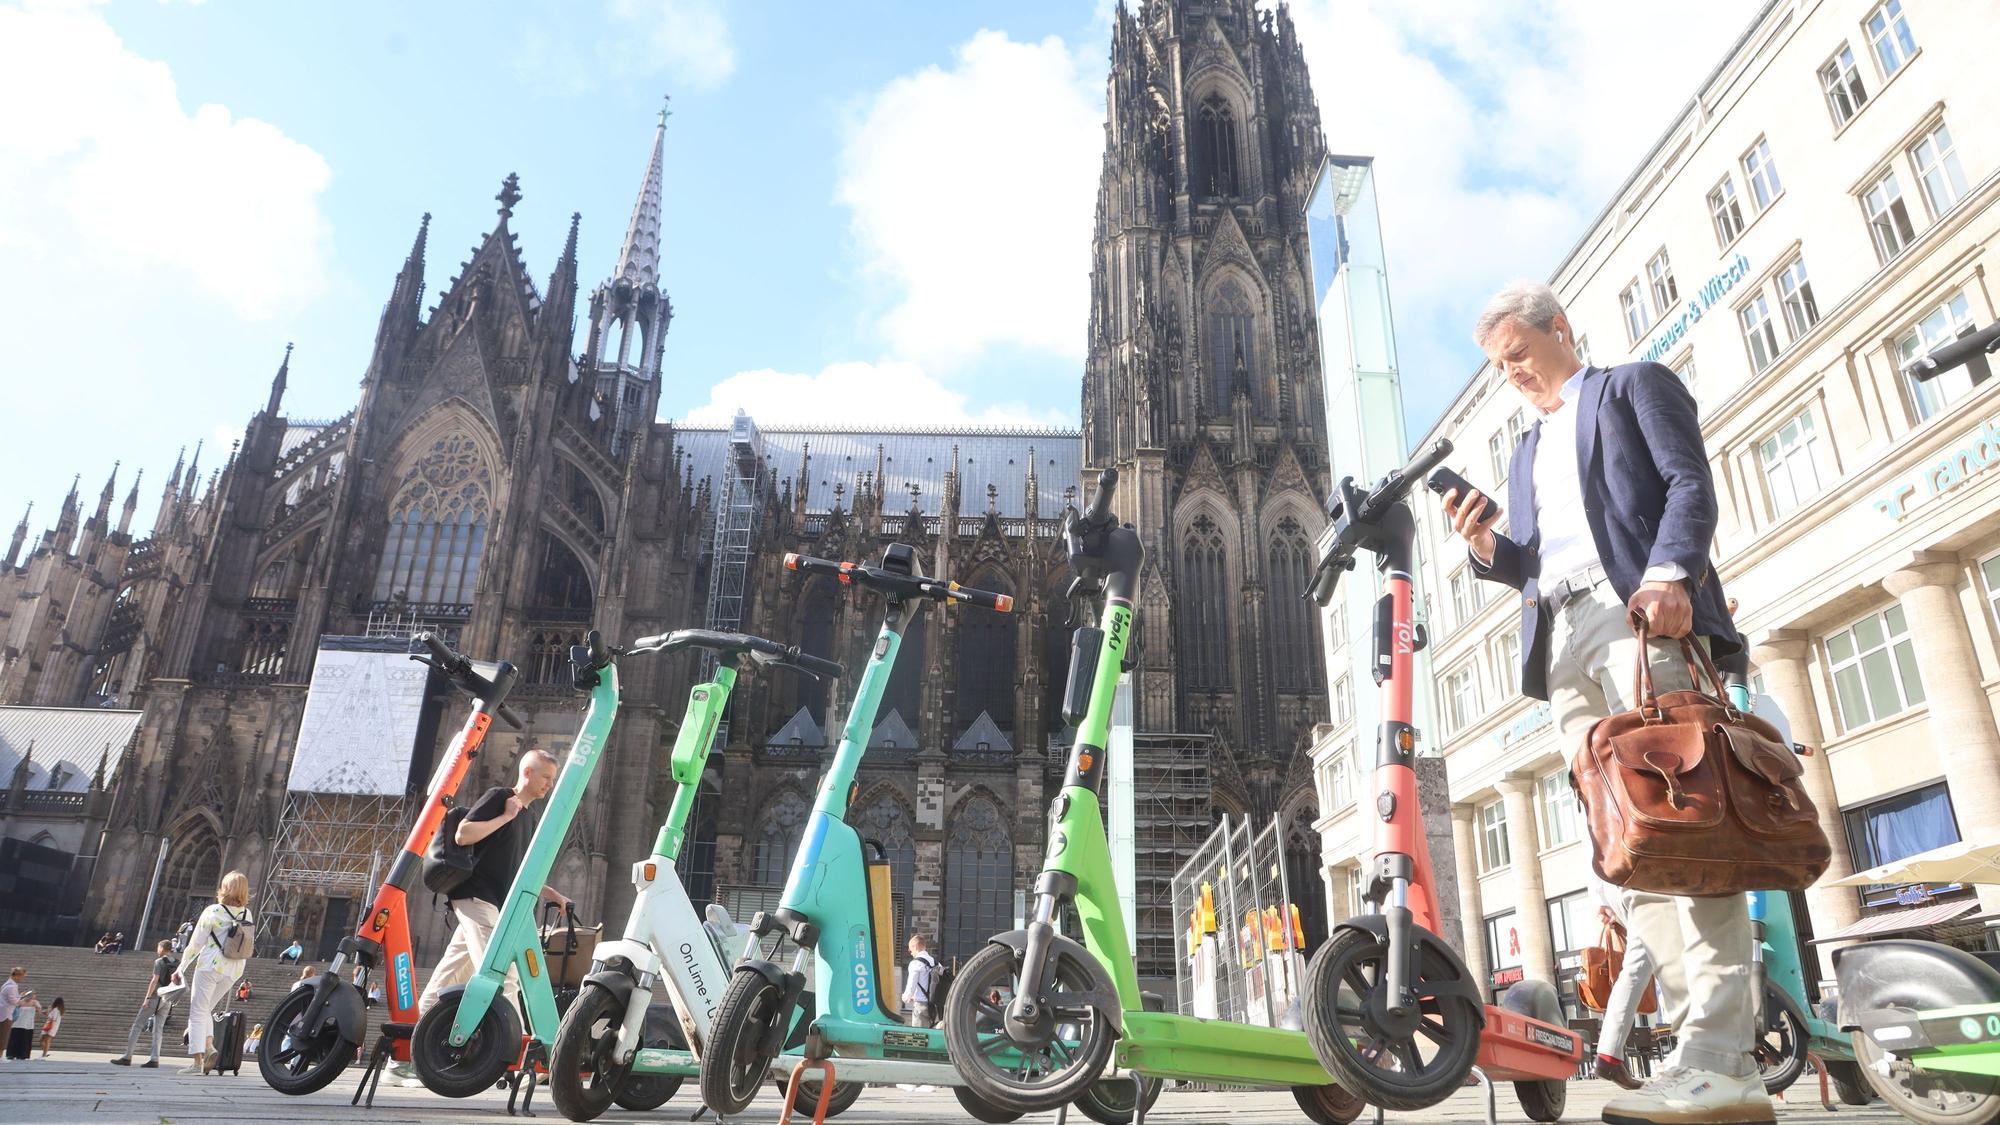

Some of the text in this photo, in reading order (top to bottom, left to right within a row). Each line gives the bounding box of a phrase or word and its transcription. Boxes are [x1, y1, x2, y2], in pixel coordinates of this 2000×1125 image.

[1640, 253, 1751, 362] nheuer & Witsch
[1109, 611, 1123, 651] ryde
[573, 732, 598, 767] Bolt
[397, 952, 409, 1009] FREI
[680, 943, 694, 964] On
[688, 963, 707, 997] Lime
[854, 963, 870, 1008] dott
